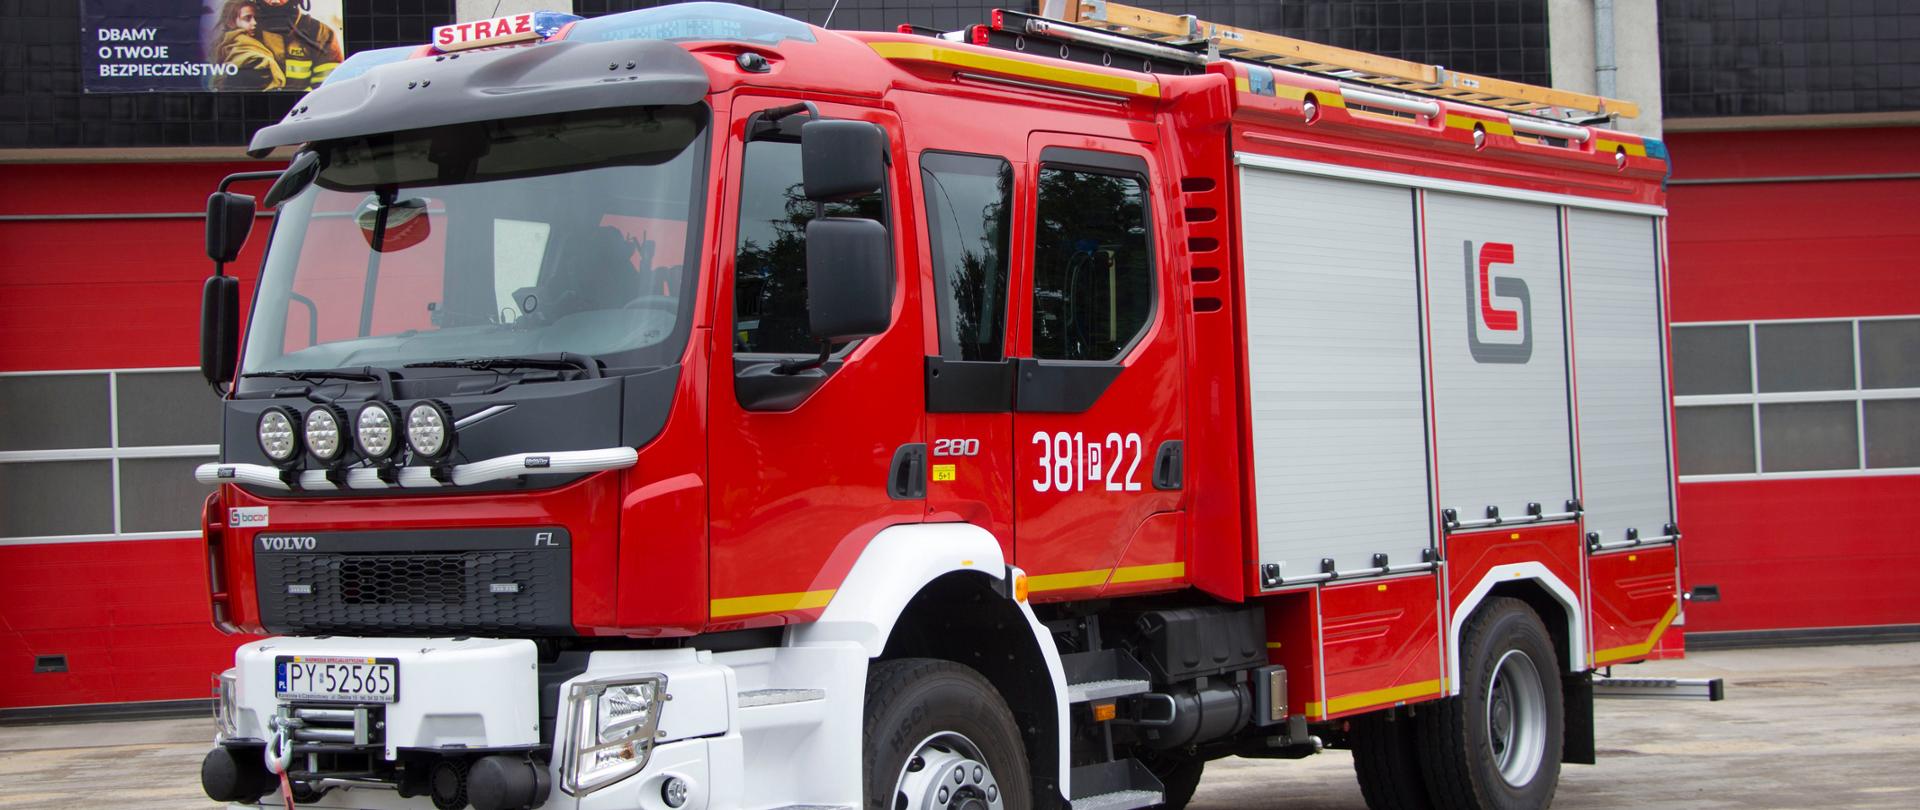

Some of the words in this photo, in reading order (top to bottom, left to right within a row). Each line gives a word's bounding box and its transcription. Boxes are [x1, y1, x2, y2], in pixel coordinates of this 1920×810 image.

[98, 28, 157, 41] DBAMY
[438, 14, 531, 45] STRAŻ
[98, 46, 112, 59] O
[114, 46, 169, 59] TWOJE
[100, 61, 239, 77] BEZPIECZEŃSTWO
[933, 438, 980, 456] 280
[242, 512, 268, 522] bocar
[260, 536, 317, 550] VOLVO
[534, 532, 559, 546] FL
[278, 681, 287, 689] PL
[290, 664, 316, 692] PY
[326, 665, 390, 694] 52565
